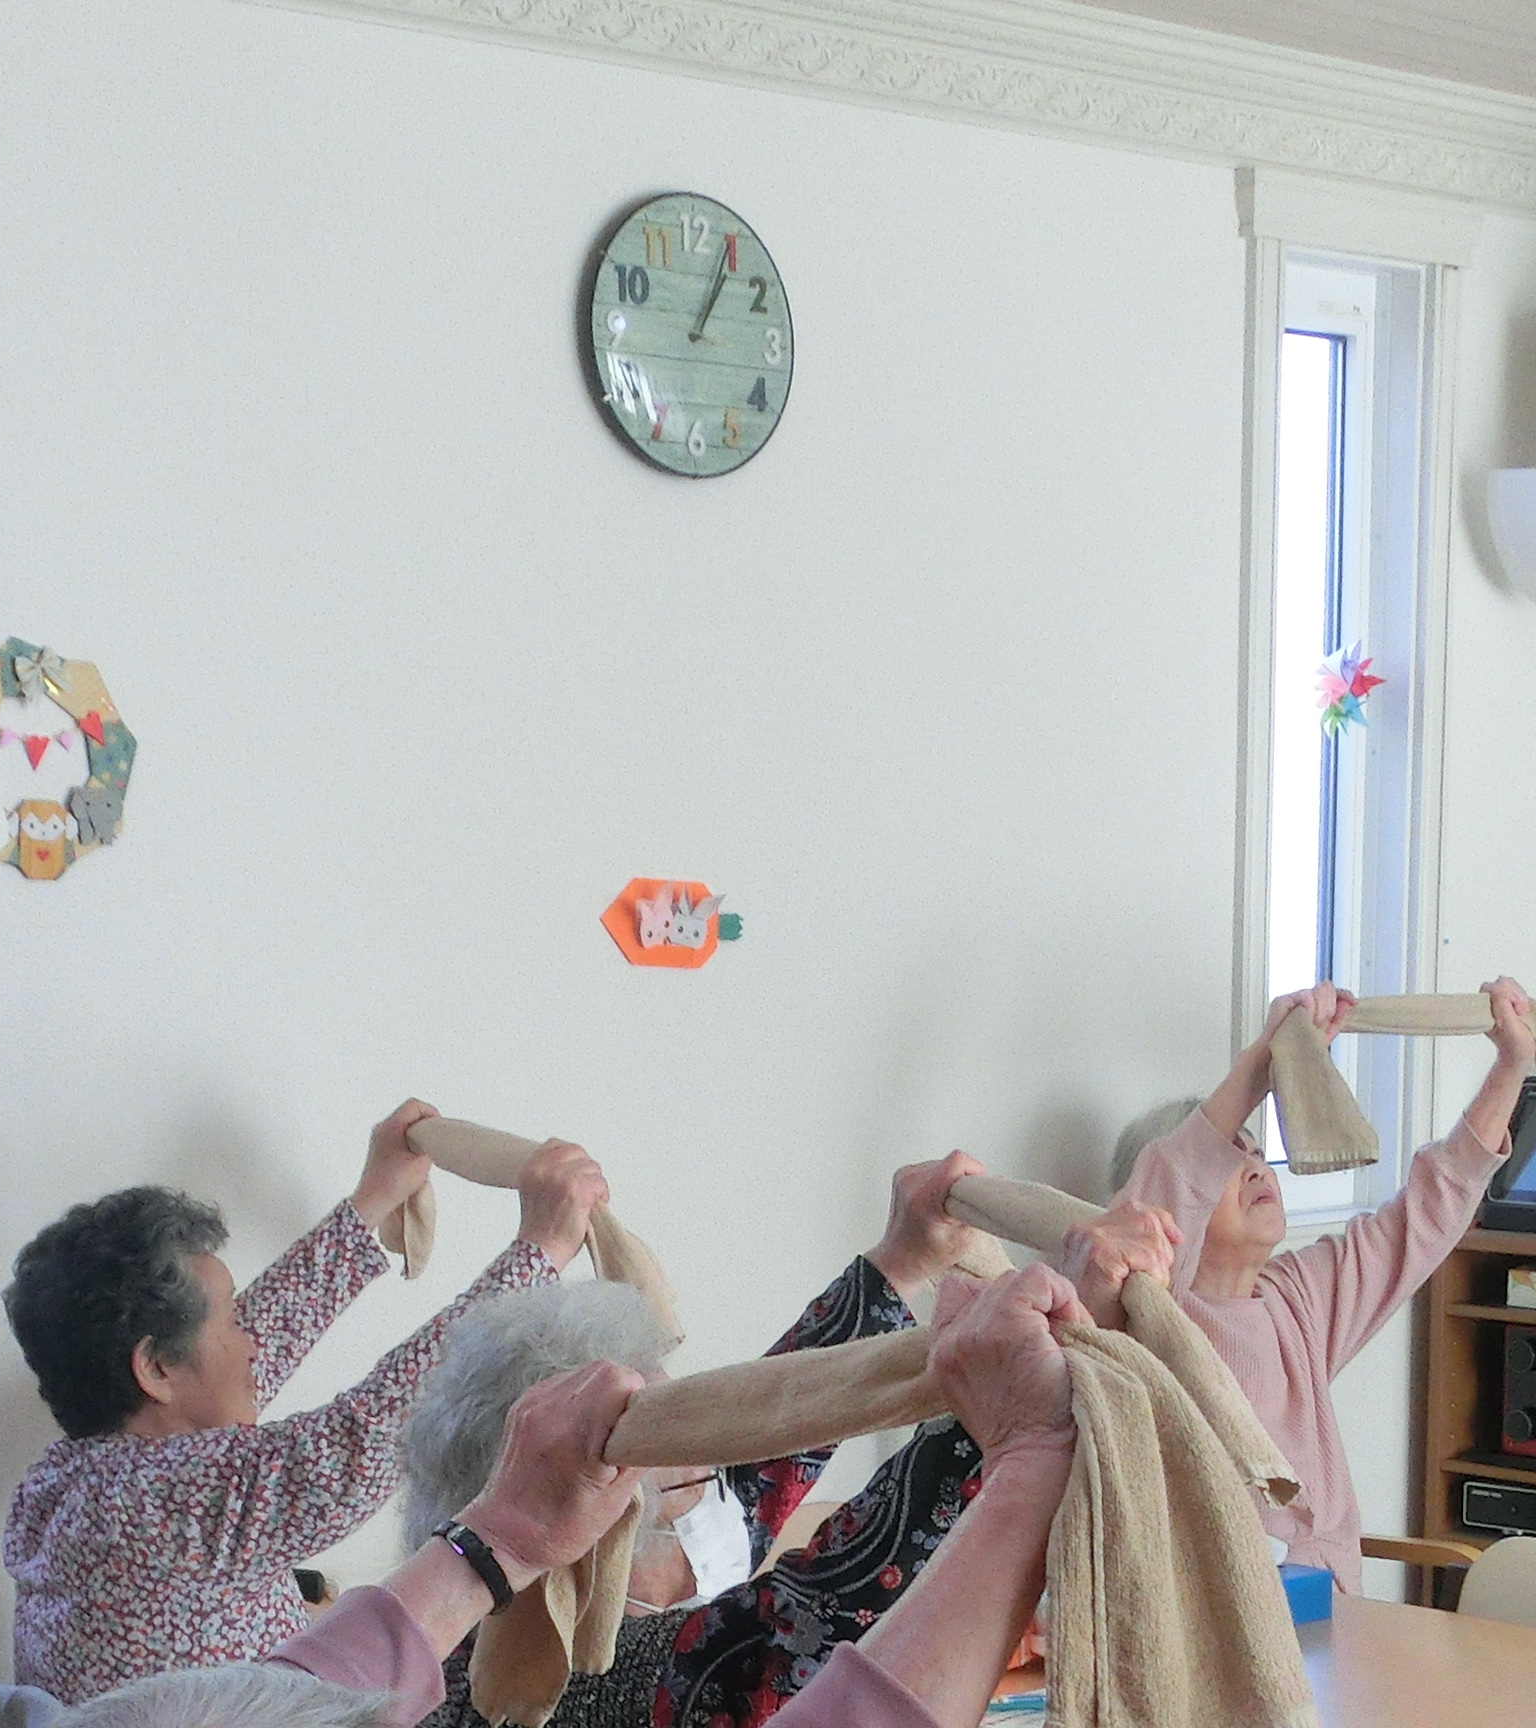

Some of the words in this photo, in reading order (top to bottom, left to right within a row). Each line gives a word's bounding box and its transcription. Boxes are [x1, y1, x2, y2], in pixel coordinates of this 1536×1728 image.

[642, 226, 671, 268] 11
[679, 212, 712, 256] 12
[724, 234, 737, 272] 1
[614, 265, 650, 304] 10
[748, 276, 767, 314] 2
[607, 309, 629, 348] 9
[764, 326, 781, 365] 3
[746, 376, 769, 413] 4
[687, 421, 706, 457] 6
[722, 408, 743, 448] 5
